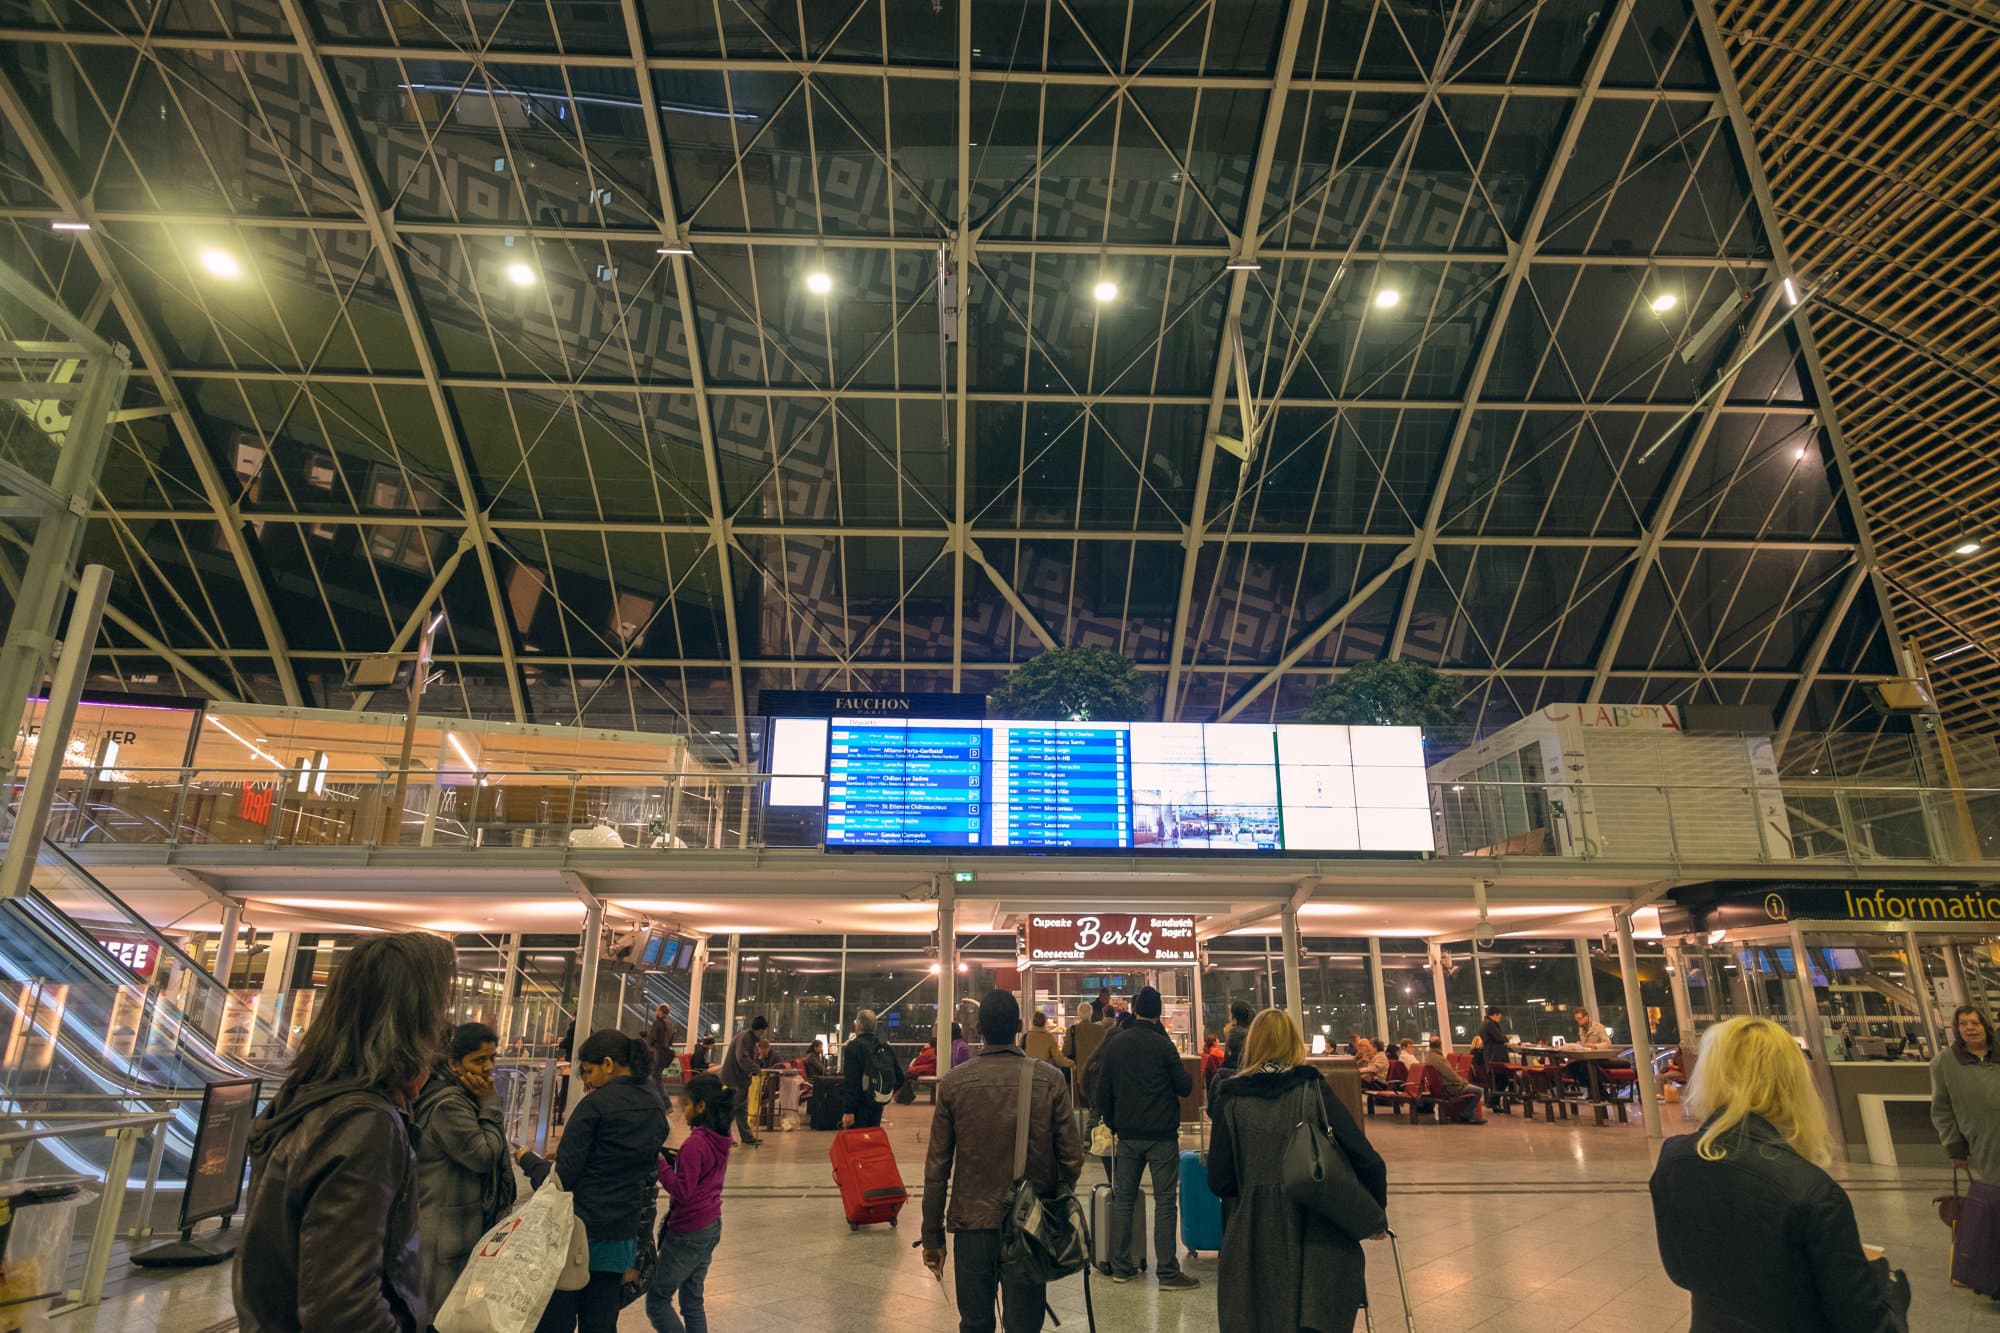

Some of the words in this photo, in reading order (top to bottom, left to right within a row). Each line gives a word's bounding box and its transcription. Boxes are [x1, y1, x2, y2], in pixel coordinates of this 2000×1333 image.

[835, 697, 910, 710] FAUCHON
[1033, 917, 1073, 928] Cupcake
[1150, 917, 1193, 928] Sandwich
[1074, 916, 1153, 954] Berko
[1161, 927, 1193, 938] Bagel's
[1032, 949, 1086, 960] Cheesecake
[1155, 949, 1195, 960] Boissns
